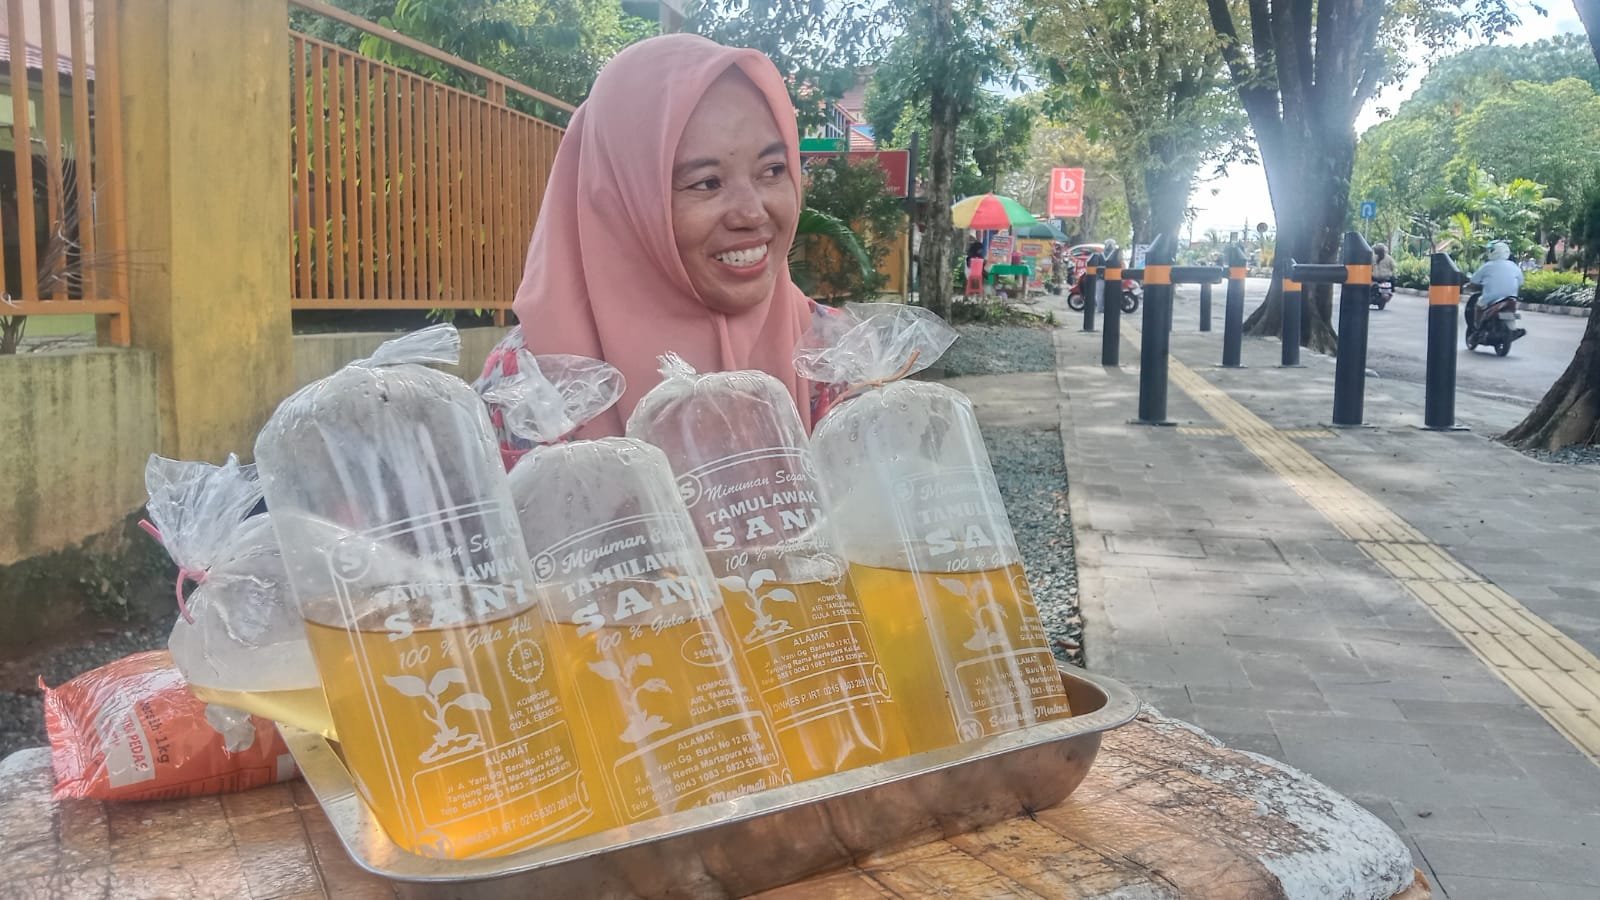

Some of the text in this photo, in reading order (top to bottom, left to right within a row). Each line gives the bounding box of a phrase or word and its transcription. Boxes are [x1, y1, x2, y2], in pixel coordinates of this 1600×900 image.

[1060, 171, 1075, 193] b
[680, 480, 696, 497] S
[703, 470, 808, 502] Minuman Segar
[706, 490, 818, 525] TAMULAWAK
[713, 508, 827, 550] SANI
[537, 558, 551, 577] S
[562, 533, 648, 574] Minuman
[725, 551, 749, 572] 100
[946, 558, 970, 573] 100
[562, 551, 684, 602] TAMULAW
[384, 579, 529, 642] SANI
[630, 624, 643, 641] %
[651, 613, 686, 637] Gula
[399, 645, 431, 669] 100
[441, 636, 456, 659] %
[465, 627, 504, 655] Gula
[128, 733, 148, 771] PEDAS
[695, 743, 718, 758] Baru
[674, 780, 697, 794] 0043
